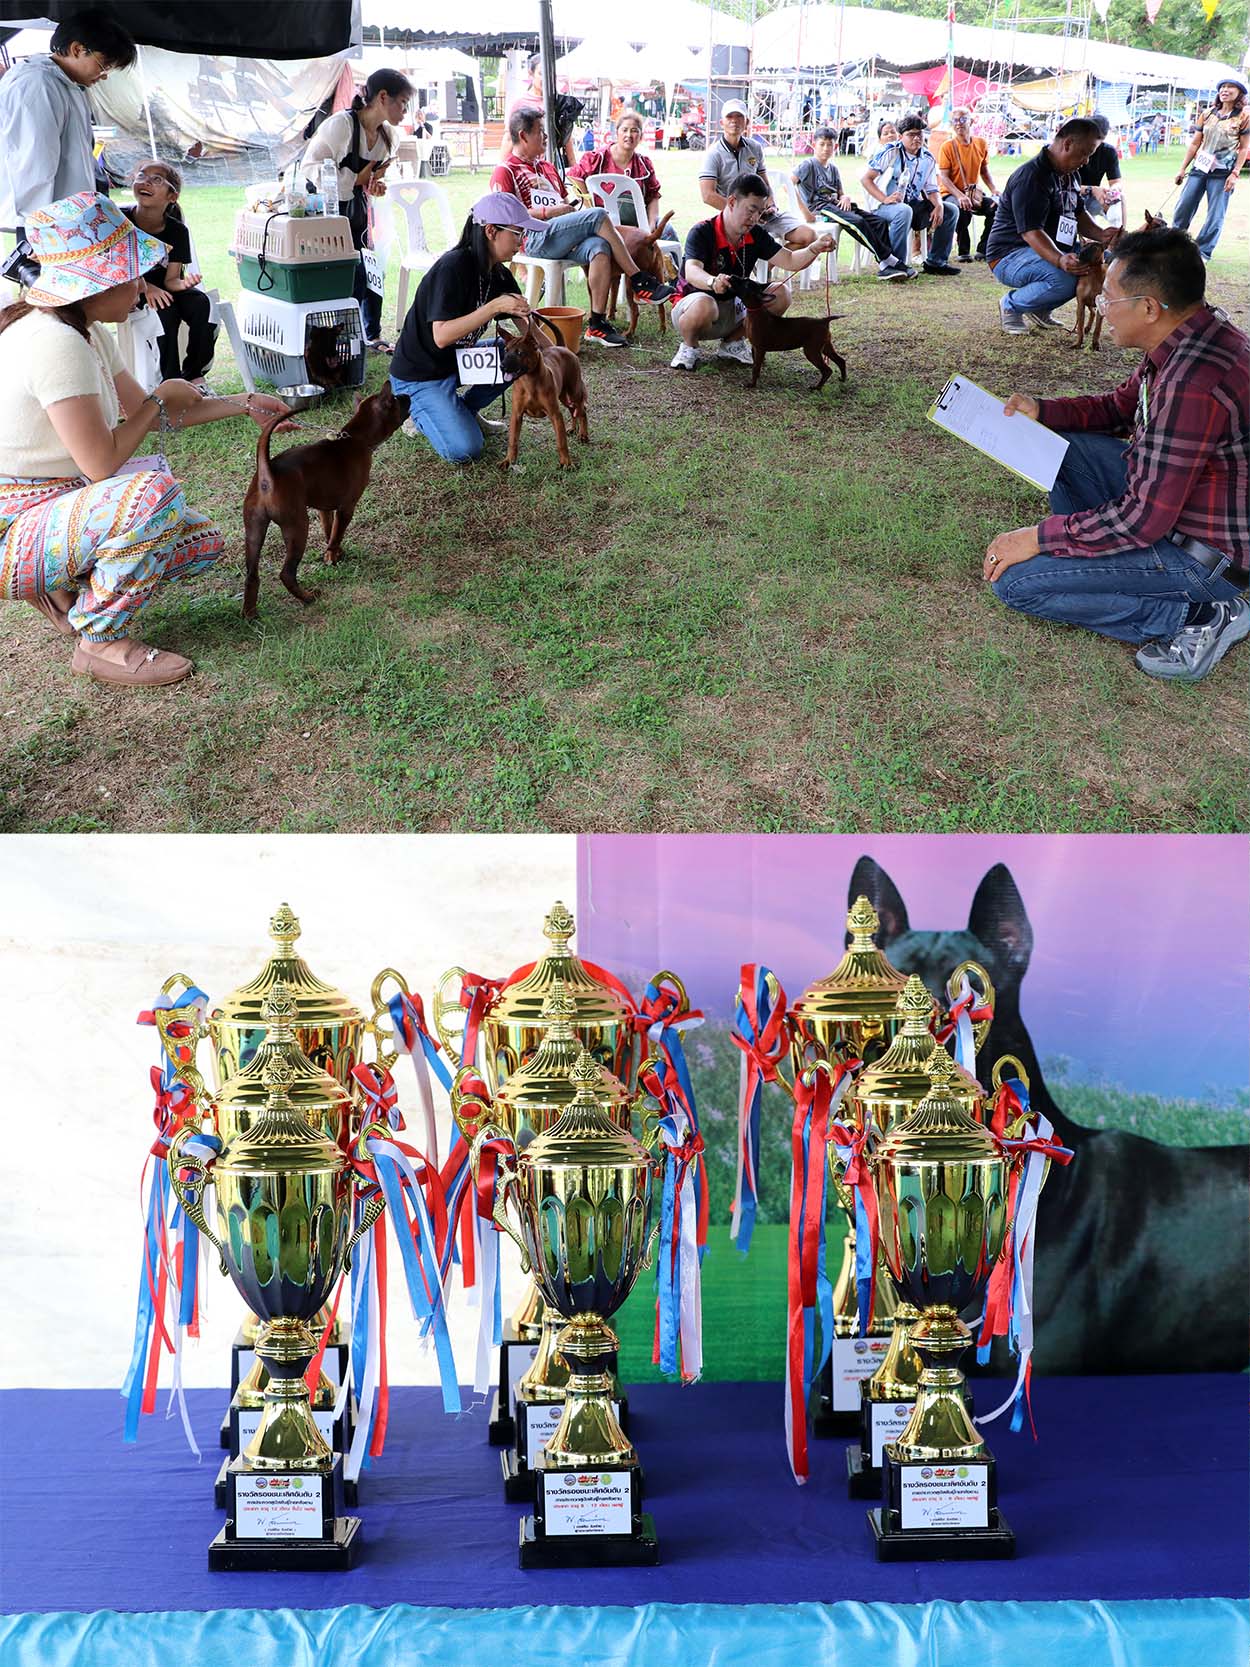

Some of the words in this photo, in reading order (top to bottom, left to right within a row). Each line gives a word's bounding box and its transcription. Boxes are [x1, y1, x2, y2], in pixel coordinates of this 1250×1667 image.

[533, 195, 557, 207] 003
[1060, 221, 1074, 235] 004
[367, 271, 382, 289] 003
[461, 352, 497, 370] 002
